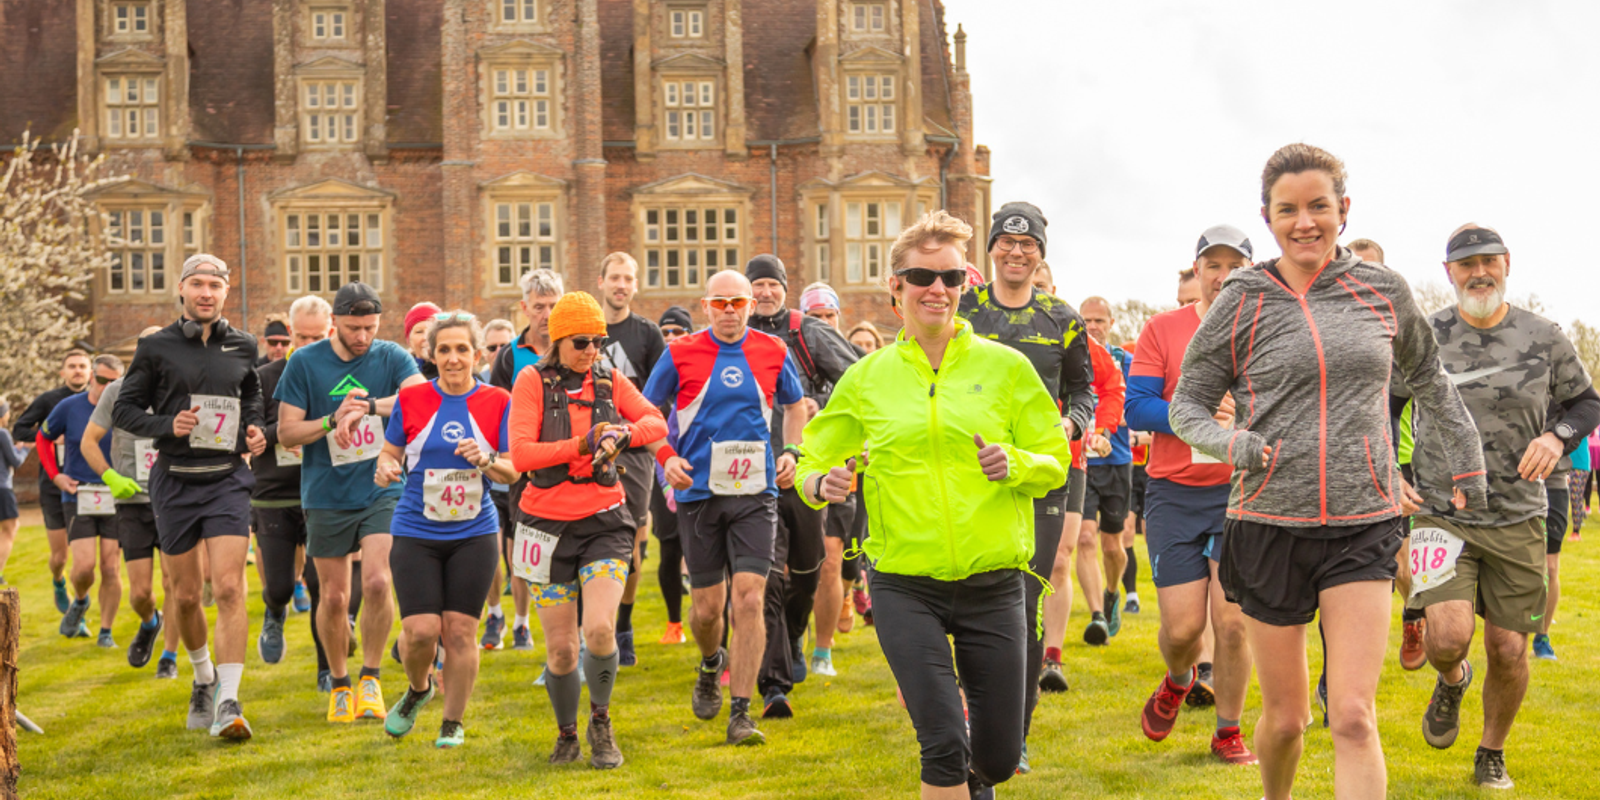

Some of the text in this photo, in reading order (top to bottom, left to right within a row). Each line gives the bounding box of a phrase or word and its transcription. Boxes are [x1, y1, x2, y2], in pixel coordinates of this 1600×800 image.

[214, 412, 227, 434] 7
[352, 423, 375, 448] 06
[727, 457, 752, 480] 42
[93, 491, 102, 505] 5
[440, 484, 465, 507] 43
[521, 539, 542, 567] 10
[1411, 546, 1448, 576] 318
